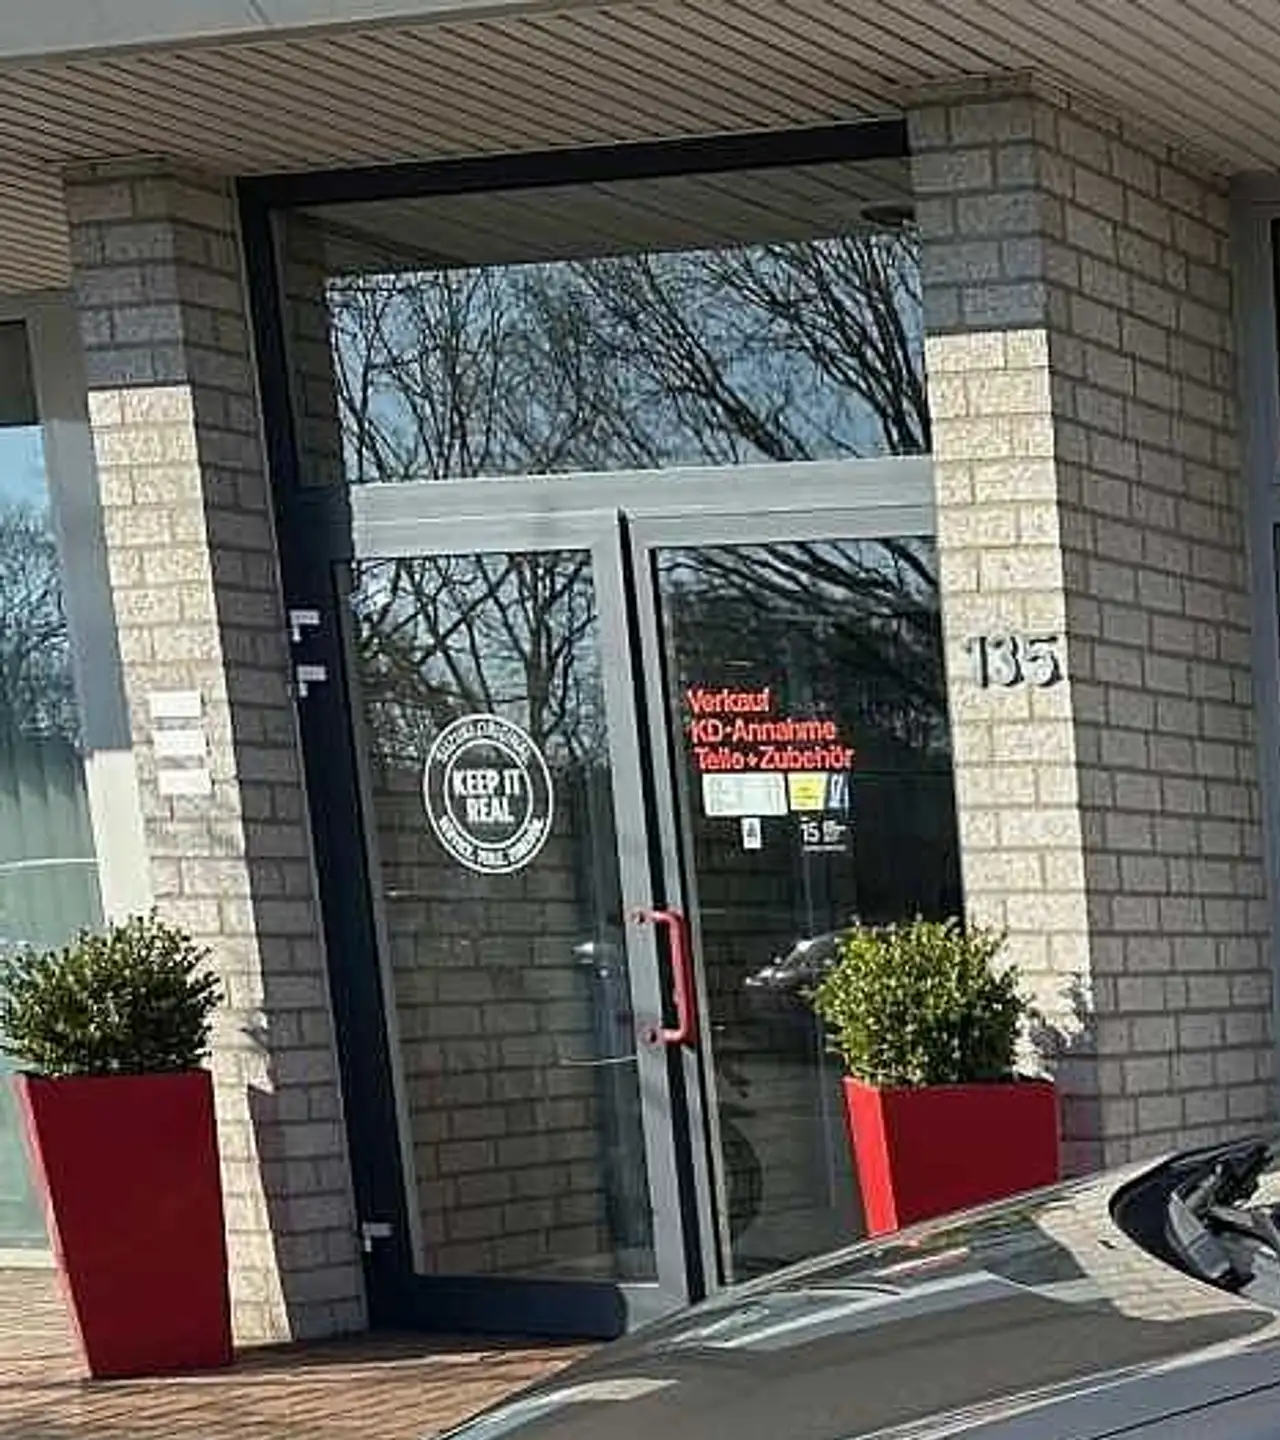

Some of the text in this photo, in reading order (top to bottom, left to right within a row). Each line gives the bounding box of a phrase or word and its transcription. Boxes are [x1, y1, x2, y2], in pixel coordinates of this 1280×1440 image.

[962, 636, 1064, 688] 135
[688, 687, 770, 713] Verkauf
[452, 767, 521, 796] KEEP IT
[465, 796, 515, 824] REAL
